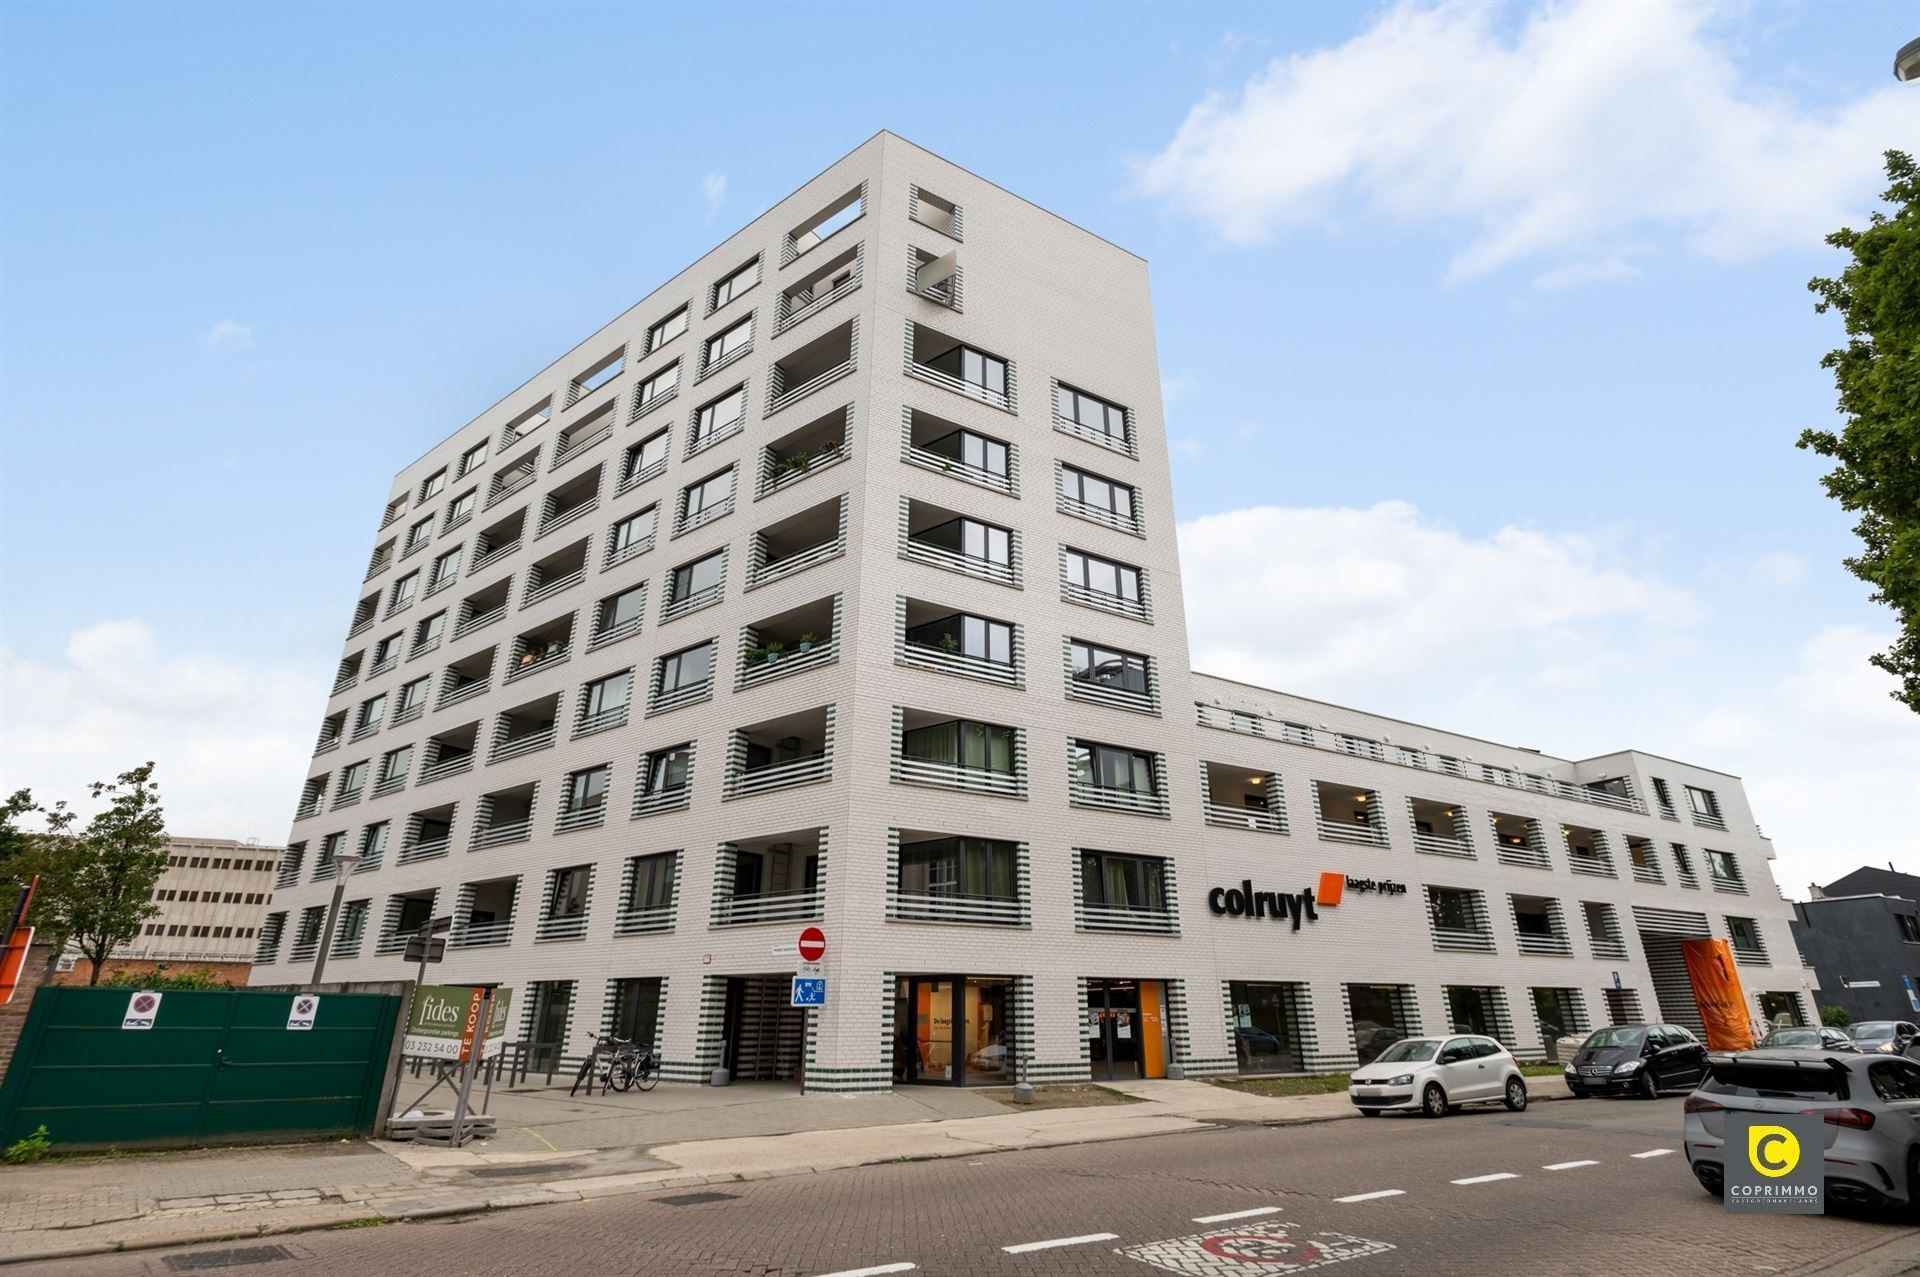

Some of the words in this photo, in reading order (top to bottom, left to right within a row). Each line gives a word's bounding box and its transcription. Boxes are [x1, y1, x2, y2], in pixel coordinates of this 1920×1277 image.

[1346, 875, 1376, 893] laagste
[1378, 879, 1407, 896] prijzen
[1209, 879, 1318, 931] colruyt
[419, 997, 459, 1025] fides
[466, 993, 481, 1032] KOOP
[405, 1041, 415, 1050] 03
[417, 1042, 432, 1052] 232
[434, 1044, 444, 1053] 54
[446, 1045, 459, 1055] 00
[461, 1038, 472, 1055] TE
